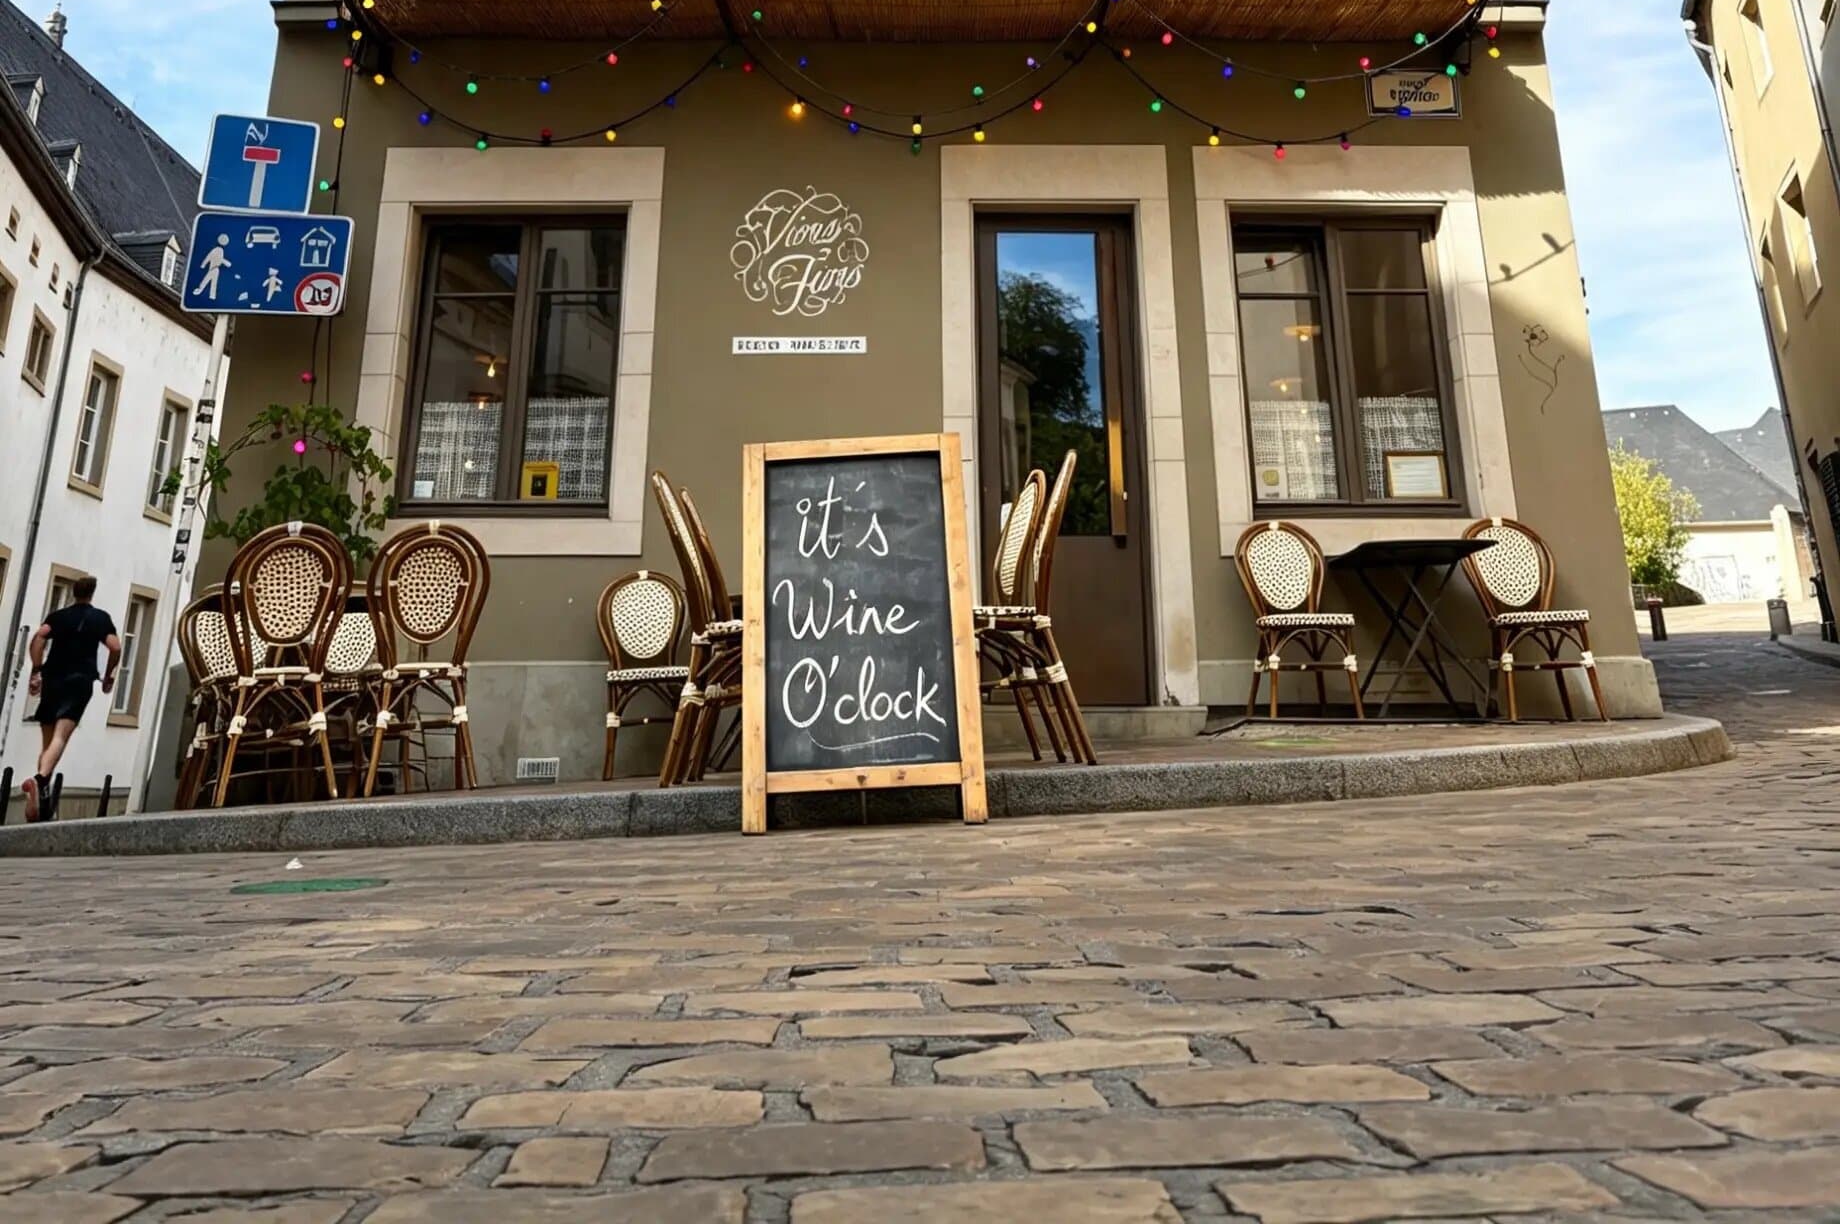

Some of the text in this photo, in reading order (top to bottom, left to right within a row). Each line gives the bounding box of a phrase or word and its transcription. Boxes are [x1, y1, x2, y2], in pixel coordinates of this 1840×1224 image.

[796, 476, 889, 559] it's
[772, 577, 920, 640] Wine
[782, 655, 947, 729] O'clock
